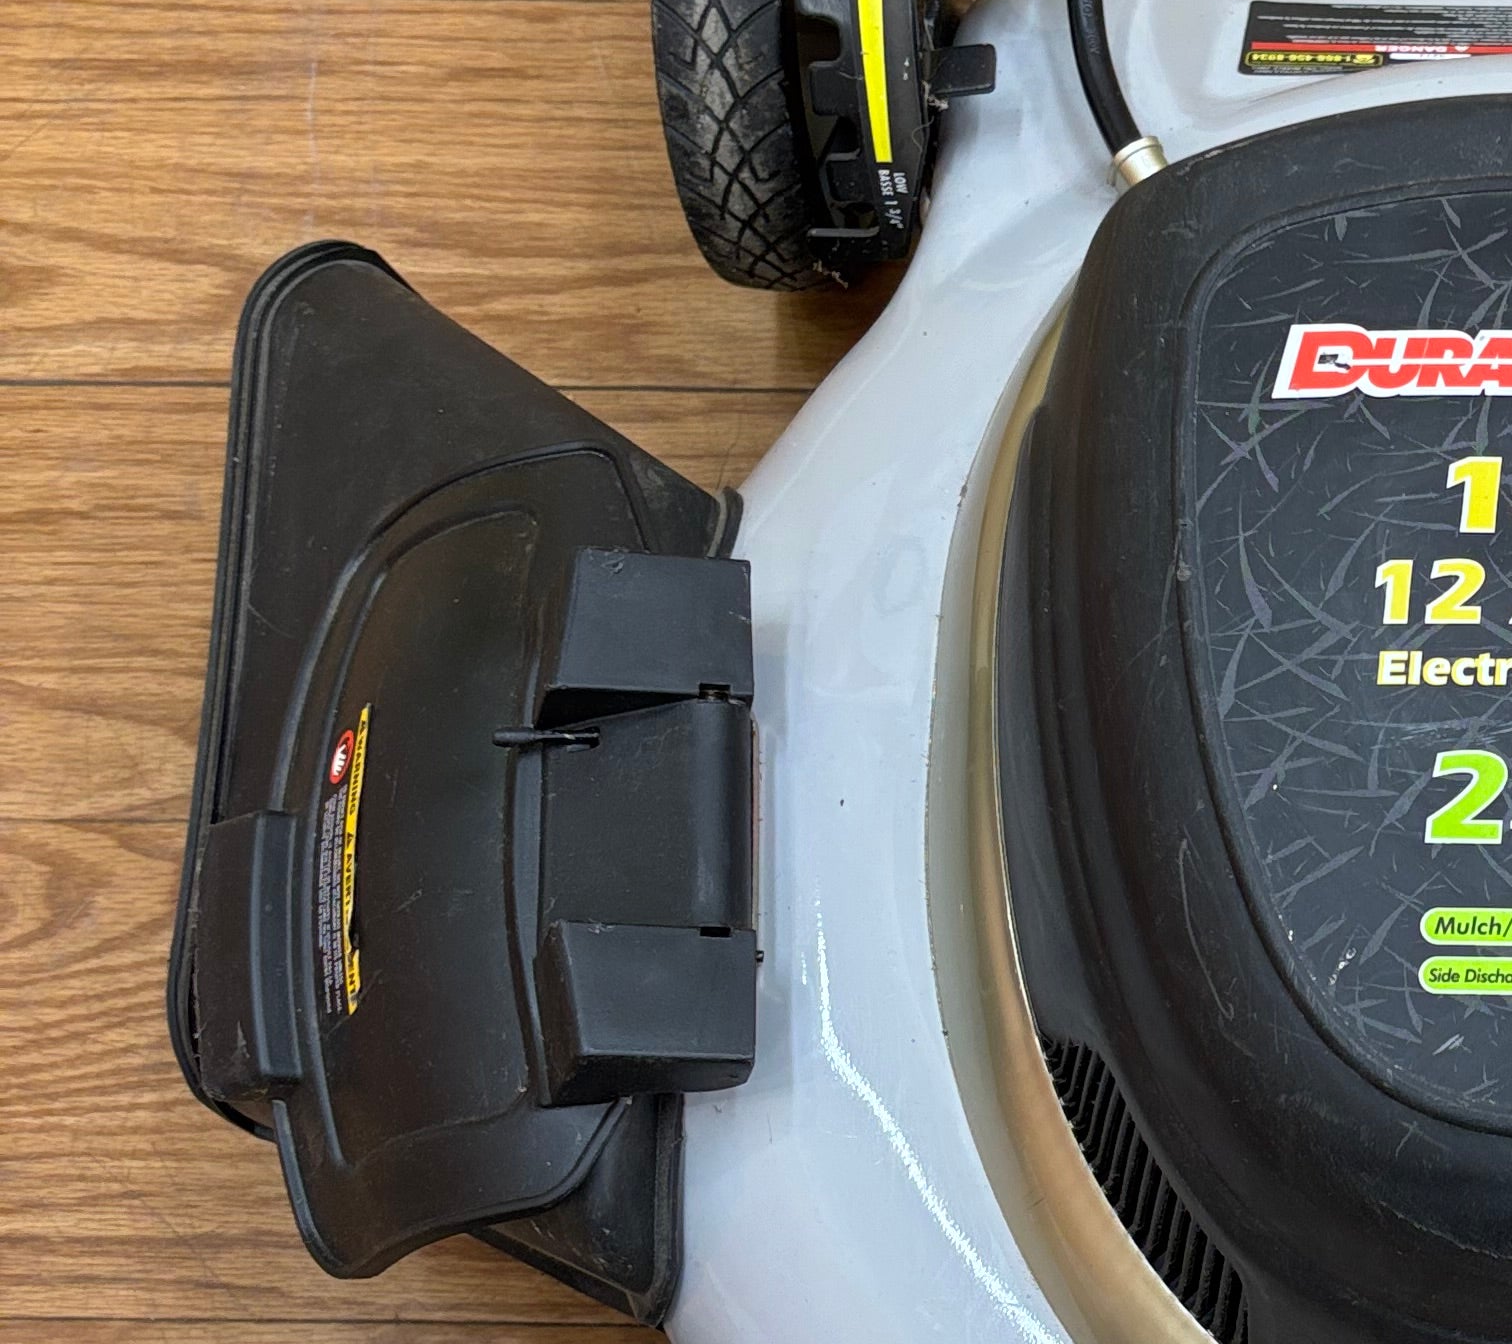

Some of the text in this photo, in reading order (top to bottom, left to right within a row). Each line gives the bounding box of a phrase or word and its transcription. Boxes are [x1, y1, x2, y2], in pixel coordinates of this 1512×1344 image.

[878, 169, 894, 197] BASSE
[893, 172, 909, 194] LOW
[1374, 558, 1486, 625] 12
[349, 735, 364, 816] WARNING
[1424, 749, 1508, 845] 2
[1429, 967, 1461, 983] Side
